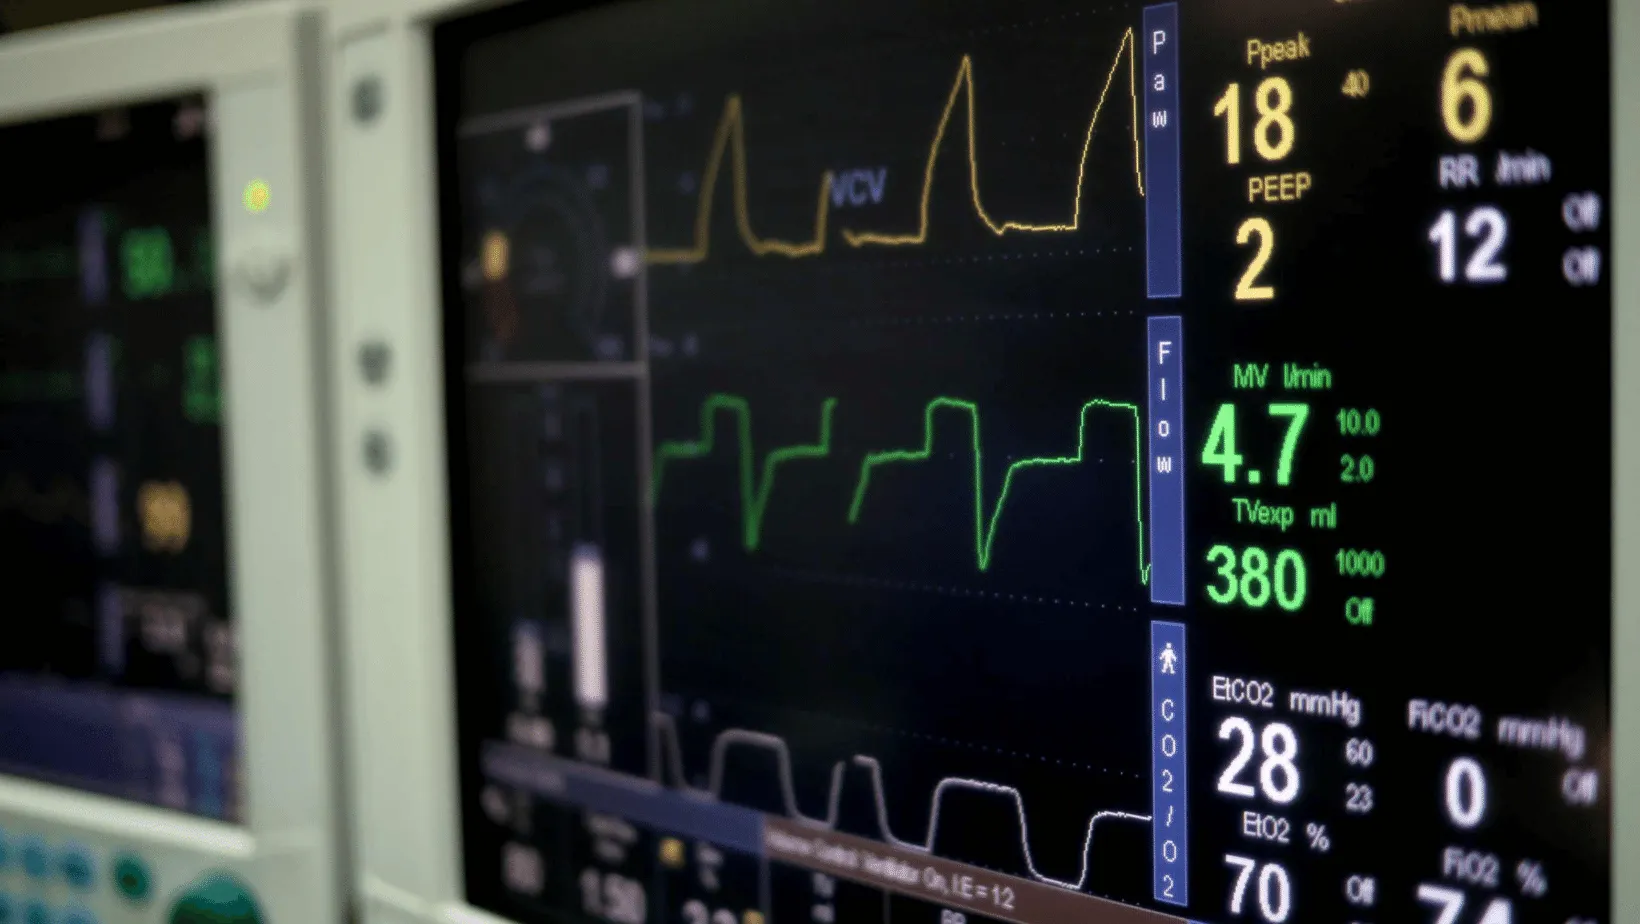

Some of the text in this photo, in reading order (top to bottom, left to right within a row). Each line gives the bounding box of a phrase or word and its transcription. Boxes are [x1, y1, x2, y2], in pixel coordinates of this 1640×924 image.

[1247, 32, 1310, 69] Ppeak
[1153, 29, 1168, 128] Paw
[1342, 70, 1369, 97] 40
[1441, 49, 1492, 142] 6
[1214, 77, 1294, 164] 18
[830, 169, 886, 206] VCV
[1249, 172, 1311, 202] PEEP
[1440, 154, 1479, 187] RR
[1234, 217, 1274, 300] 2
[1429, 207, 1507, 282] 12
[1234, 363, 1269, 388] MV
[1157, 340, 1172, 474] Flow
[1336, 408, 1380, 435] 10.0
[1201, 403, 1309, 485] 4.7
[1341, 454, 1374, 482] 2.0
[1232, 498, 1336, 531] TVexp ml
[1206, 545, 1306, 611] 380
[1336, 549, 1385, 577] 1000
[1346, 597, 1374, 624] Off
[1212, 676, 1361, 728] EtCO2 mmHg
[1408, 699, 1585, 761] FiCO2 mmHg
[1217, 716, 1300, 804] 28
[1345, 738, 1374, 767] 60
[1161, 698, 1178, 898] CO2/O2
[1346, 782, 1373, 812] 23
[1445, 757, 1486, 828] 0
[1243, 811, 1330, 851] EtO2 %
[975, 884, 988, 899] =
[1225, 854, 1291, 924] 70
[1443, 847, 1548, 896] FiO2 %
